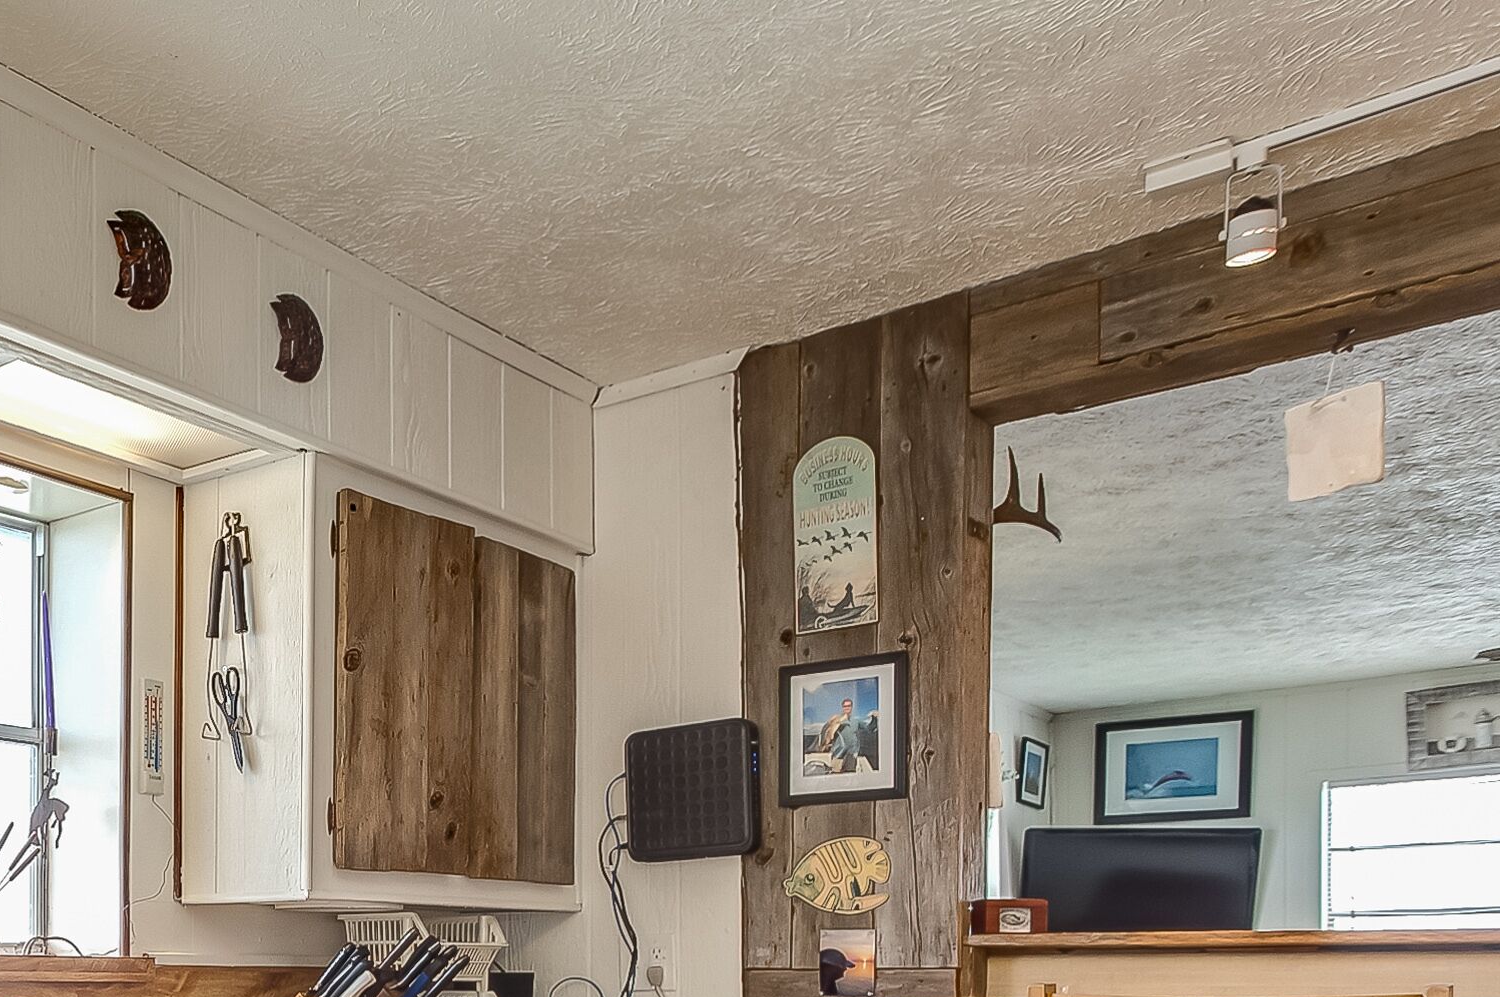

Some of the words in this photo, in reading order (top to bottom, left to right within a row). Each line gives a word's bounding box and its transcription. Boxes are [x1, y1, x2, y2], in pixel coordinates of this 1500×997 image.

[799, 445, 839, 485] BUSINESS
[840, 445, 868, 472] HOURS
[818, 466, 848, 481] SUBJECT
[813, 483, 823, 493] TO
[823, 475, 854, 490] CHANGE
[820, 488, 848, 502] DURING
[800, 502, 835, 528] HUNTING
